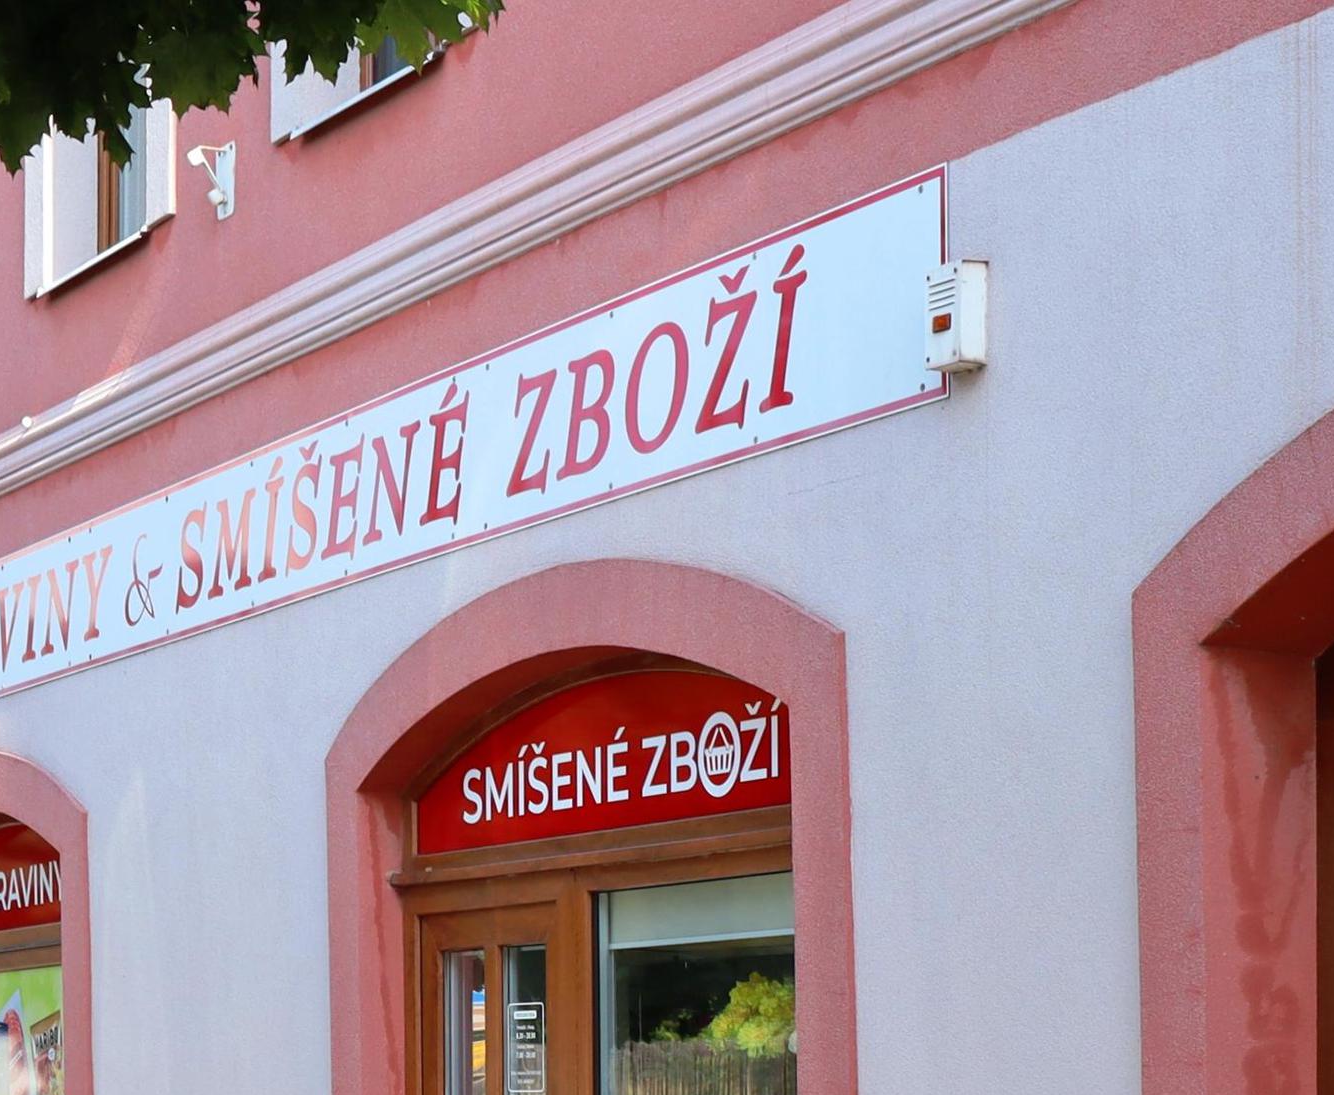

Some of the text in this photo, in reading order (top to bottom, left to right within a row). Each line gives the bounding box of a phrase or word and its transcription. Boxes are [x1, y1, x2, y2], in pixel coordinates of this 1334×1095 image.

[124, 533, 164, 627] &
[175, 382, 470, 615] SMÍŠENÉ
[505, 244, 808, 498] ZBOŽÍ
[463, 698, 781, 825] SMÍŠENÉ ZBOŽÍ
